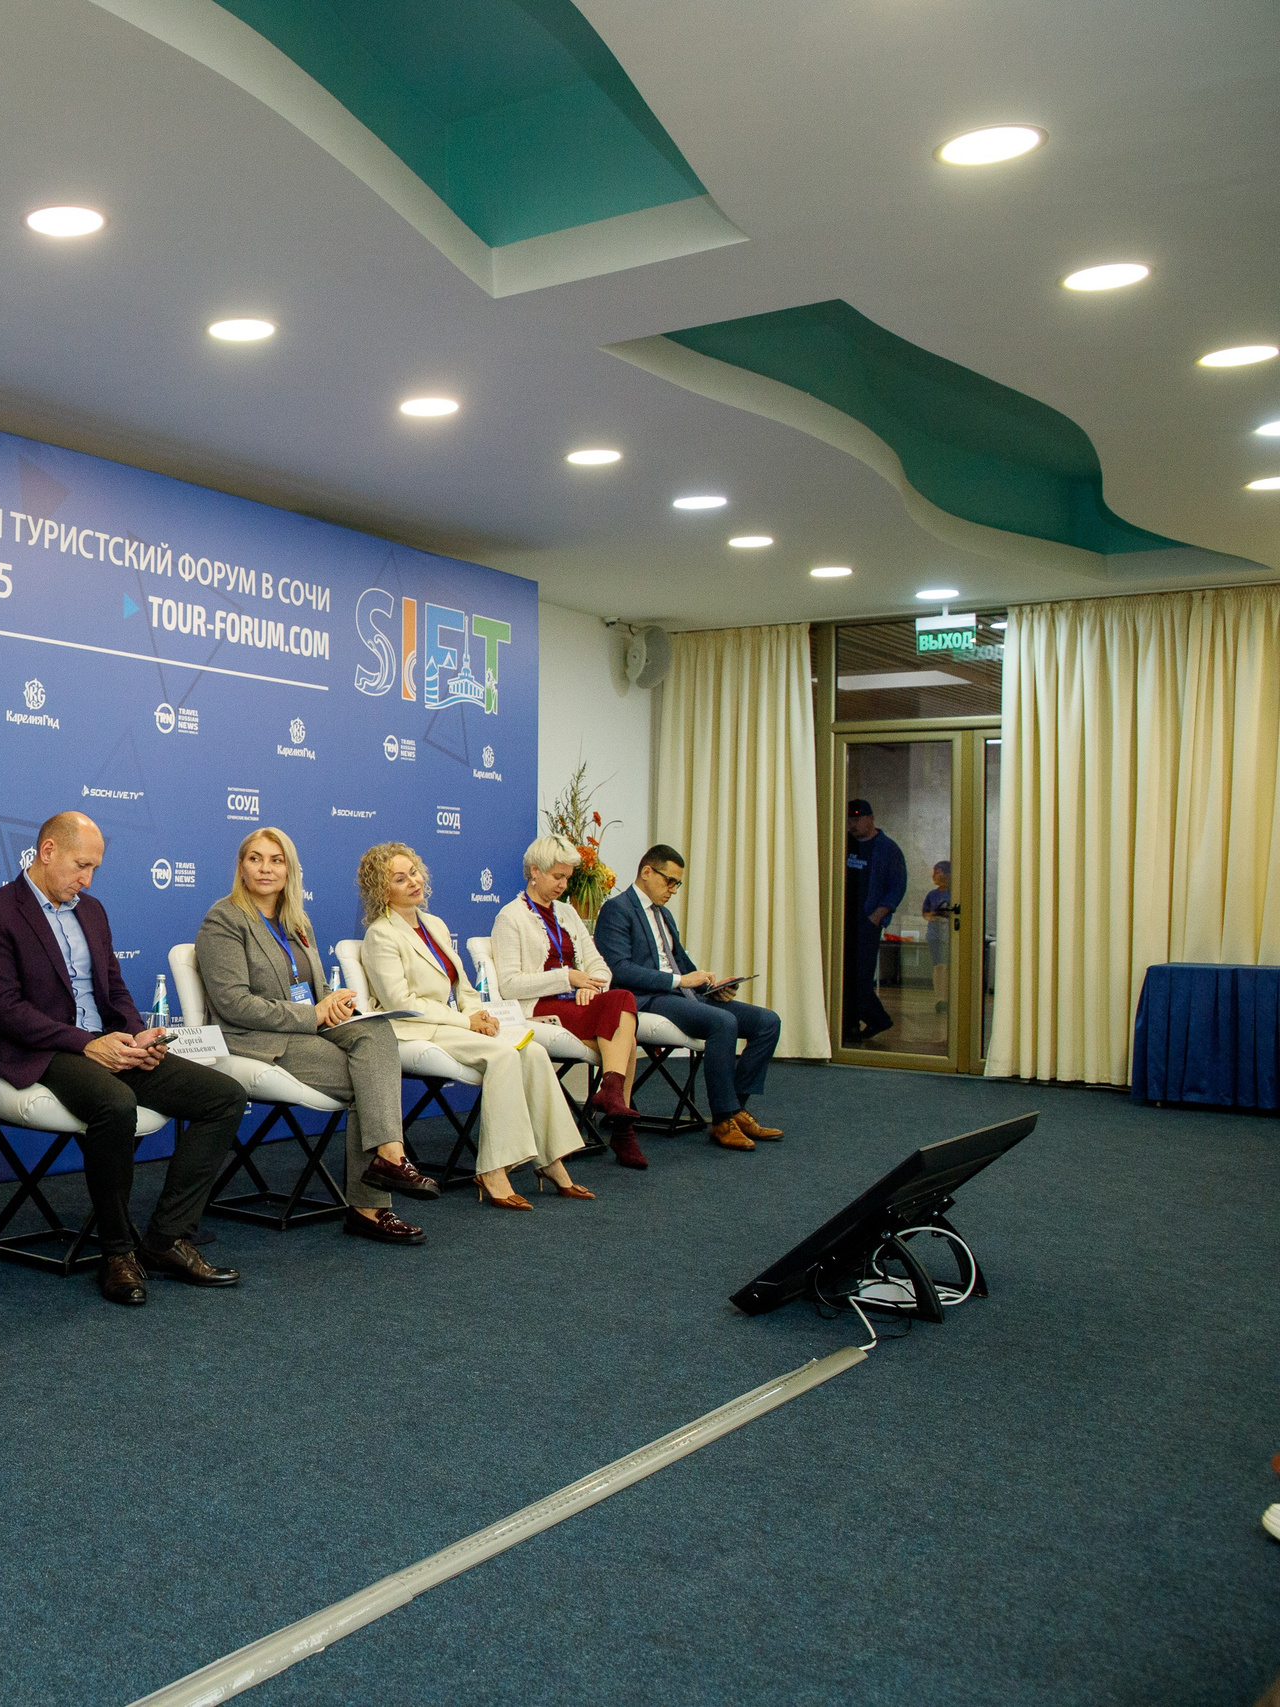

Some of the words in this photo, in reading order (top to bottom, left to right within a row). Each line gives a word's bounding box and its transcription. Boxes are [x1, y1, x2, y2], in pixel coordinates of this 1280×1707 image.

[10, 511, 173, 577] ТУРИСТСКИЙ
[178, 552, 257, 594] ФОРУМ
[262, 571, 275, 600] В
[278, 576, 331, 613] СОЧИ
[148, 595, 331, 660] TOUR-FORUM.COM
[918, 631, 974, 651] ВЫХОД
[354, 587, 512, 716] SIFT
[6, 709, 60, 730] КарелияГид
[178, 707, 199, 717] TRAVEL
[178, 720, 199, 731] NEWS
[277, 744, 316, 761] КарелияГид
[227, 794, 260, 815] СОУД
[436, 811, 461, 829] СОУД
[175, 861, 196, 869] TRAVEL
[174, 875, 196, 883] NEWS
